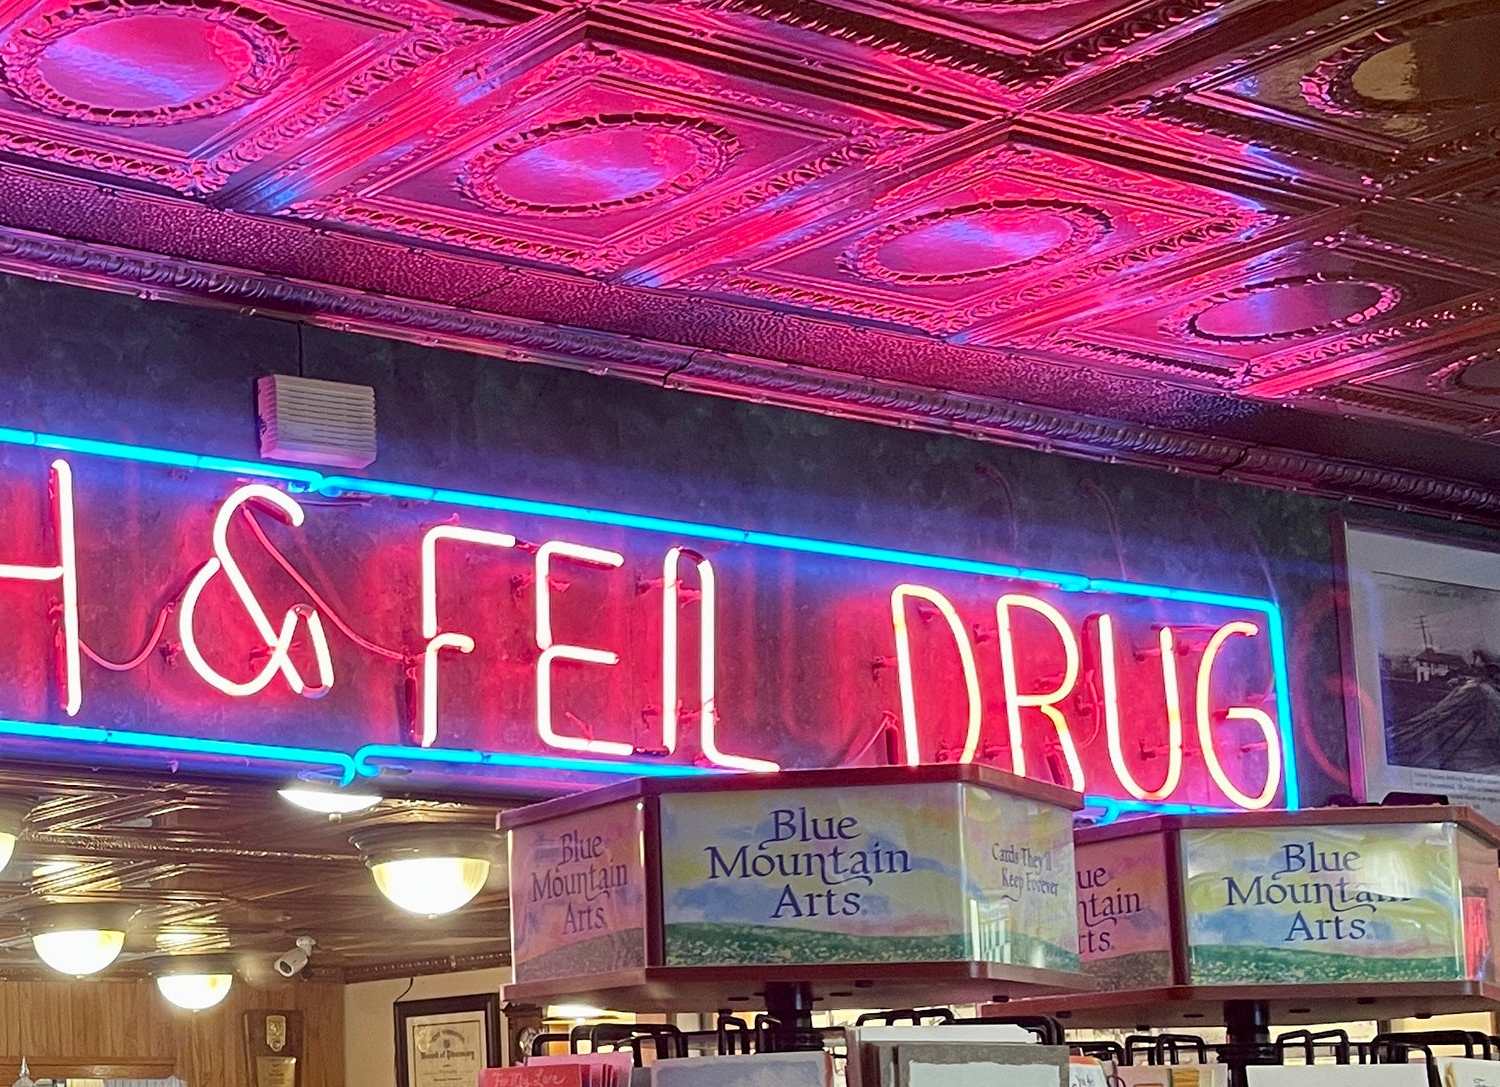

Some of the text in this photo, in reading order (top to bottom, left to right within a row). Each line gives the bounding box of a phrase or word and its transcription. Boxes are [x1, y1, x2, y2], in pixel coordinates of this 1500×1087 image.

[178, 483, 336, 698] &
[419, 524, 781, 773] FEIL
[890, 582, 1283, 811] DRUG
[760, 807, 862, 849] Blue
[560, 829, 603, 866] Blue
[704, 842, 912, 886] Mountain
[991, 842, 1052, 876] Cards They'll
[1272, 843, 1361, 881] Blue
[531, 859, 629, 902] Mountain
[1001, 866, 1059, 902] Keep Forever
[1077, 866, 1107, 890] ue
[563, 902, 606, 936] Arts
[770, 883, 862, 920] Arts
[1077, 887, 1143, 928] ntain
[1078, 930, 1112, 955] rts
[1283, 912, 1367, 943] Arts
